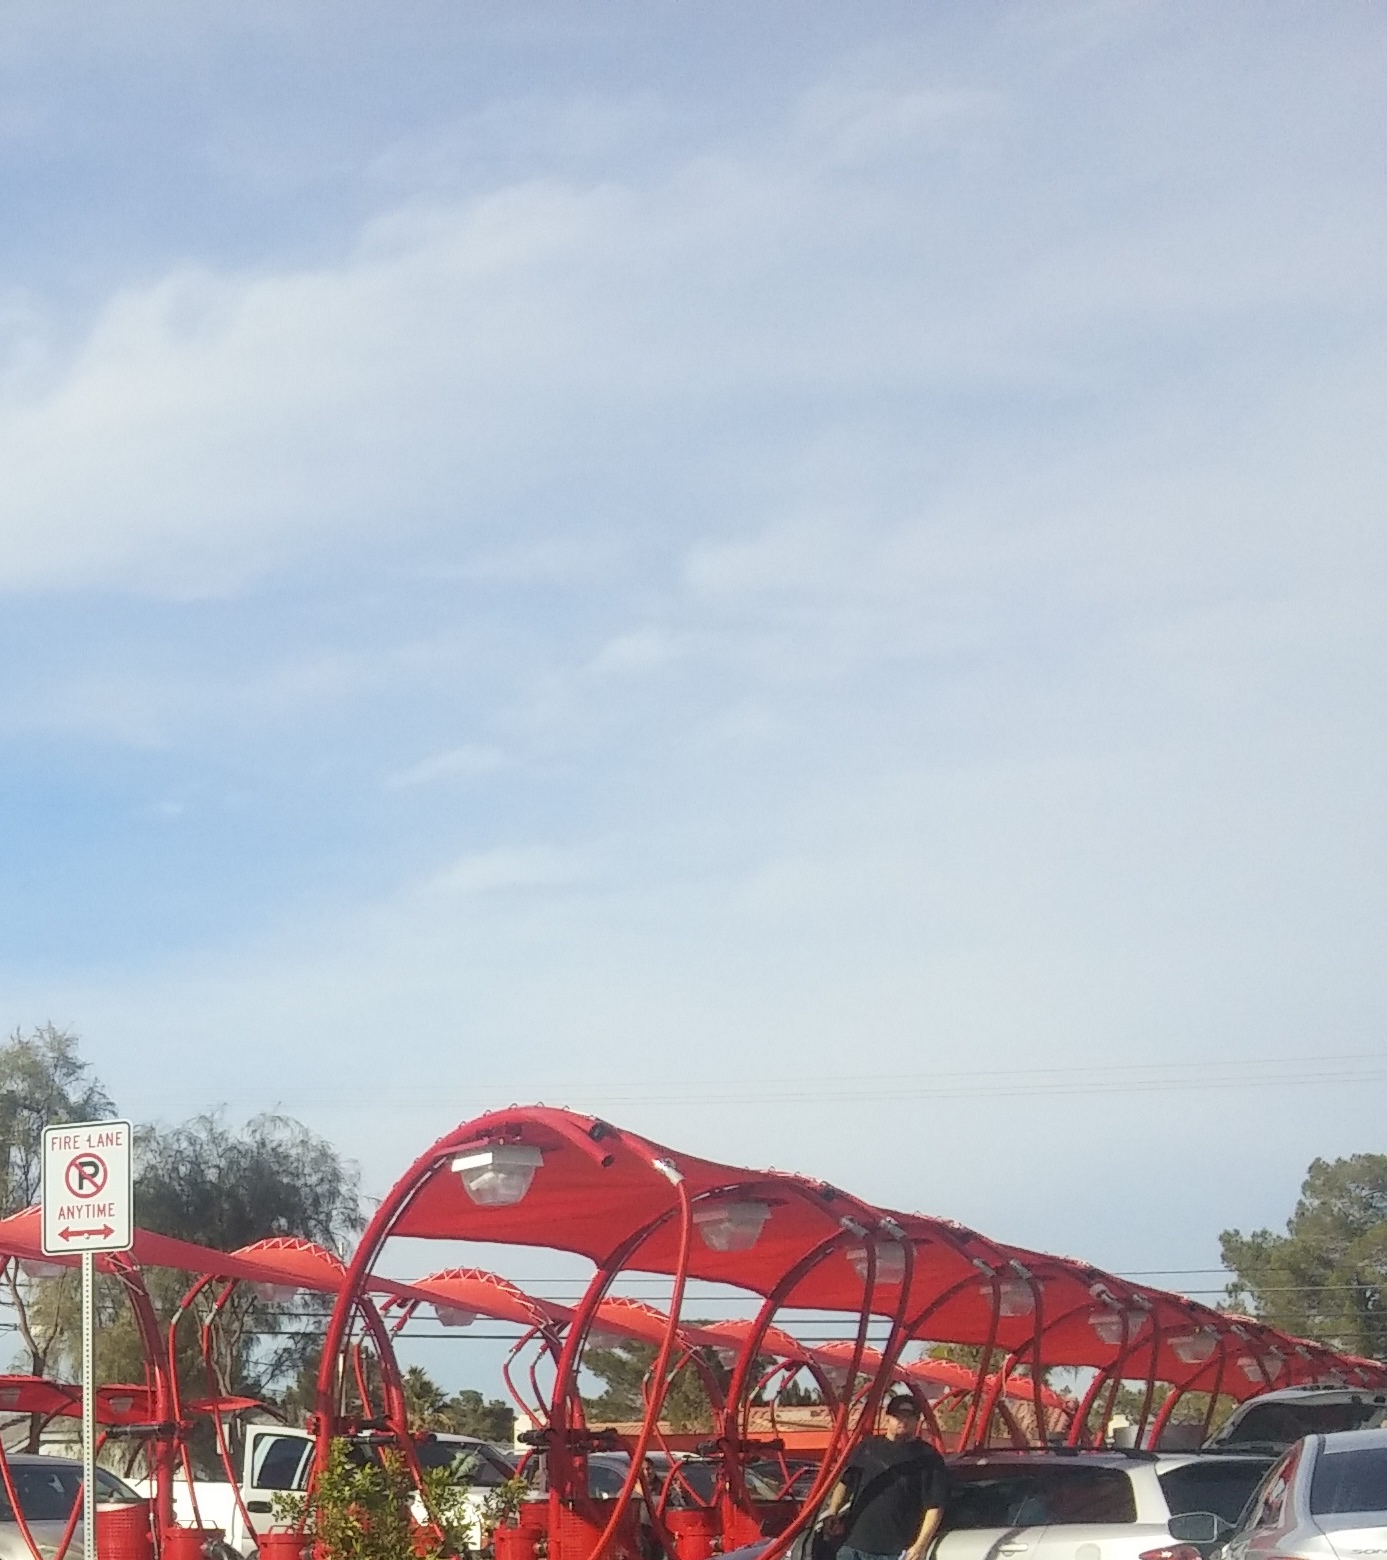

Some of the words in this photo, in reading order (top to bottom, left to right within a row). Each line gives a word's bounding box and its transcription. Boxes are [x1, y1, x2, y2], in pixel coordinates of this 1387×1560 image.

[51, 1135, 80, 1151] FIRE
[88, 1132, 123, 1148] LANE
[58, 1203, 115, 1220] ANYTIME
